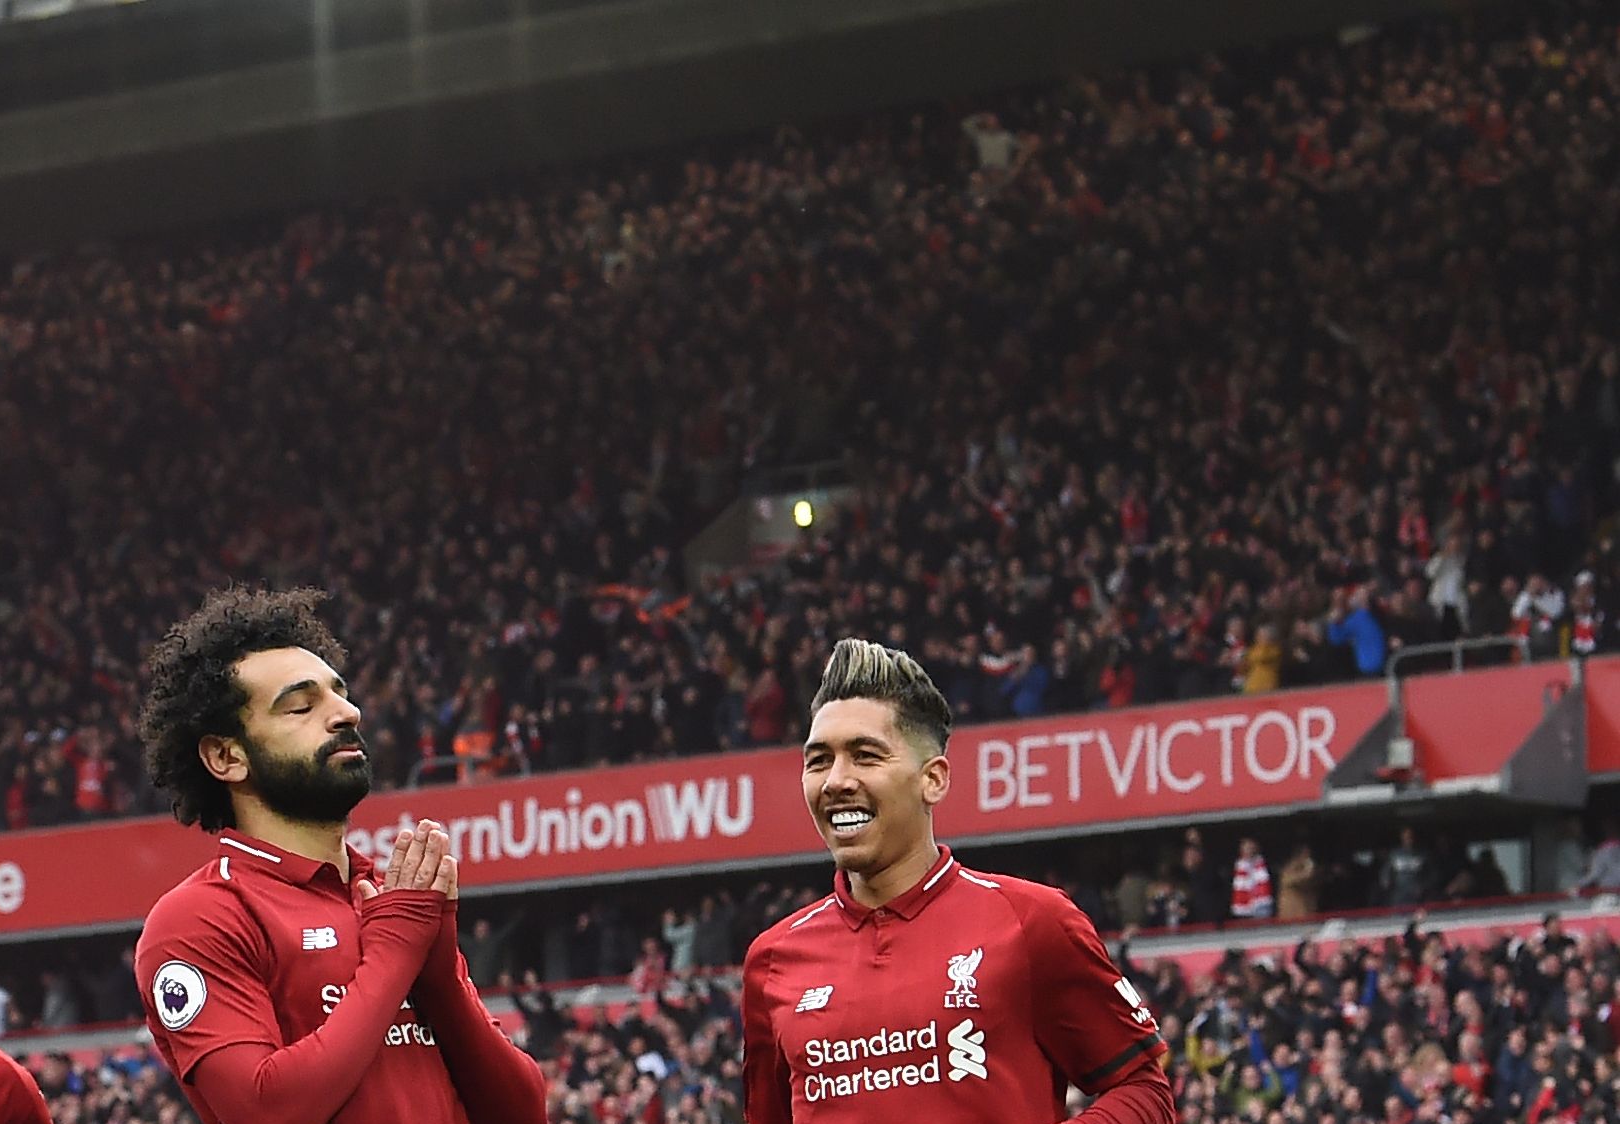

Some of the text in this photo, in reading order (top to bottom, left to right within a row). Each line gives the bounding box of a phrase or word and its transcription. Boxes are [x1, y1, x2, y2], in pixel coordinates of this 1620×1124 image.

[978, 706, 1337, 813] BETVICTOR
[346, 786, 647, 872] esrnUnion
[805, 1020, 937, 1067] Standard
[804, 1054, 941, 1102] Chartered
